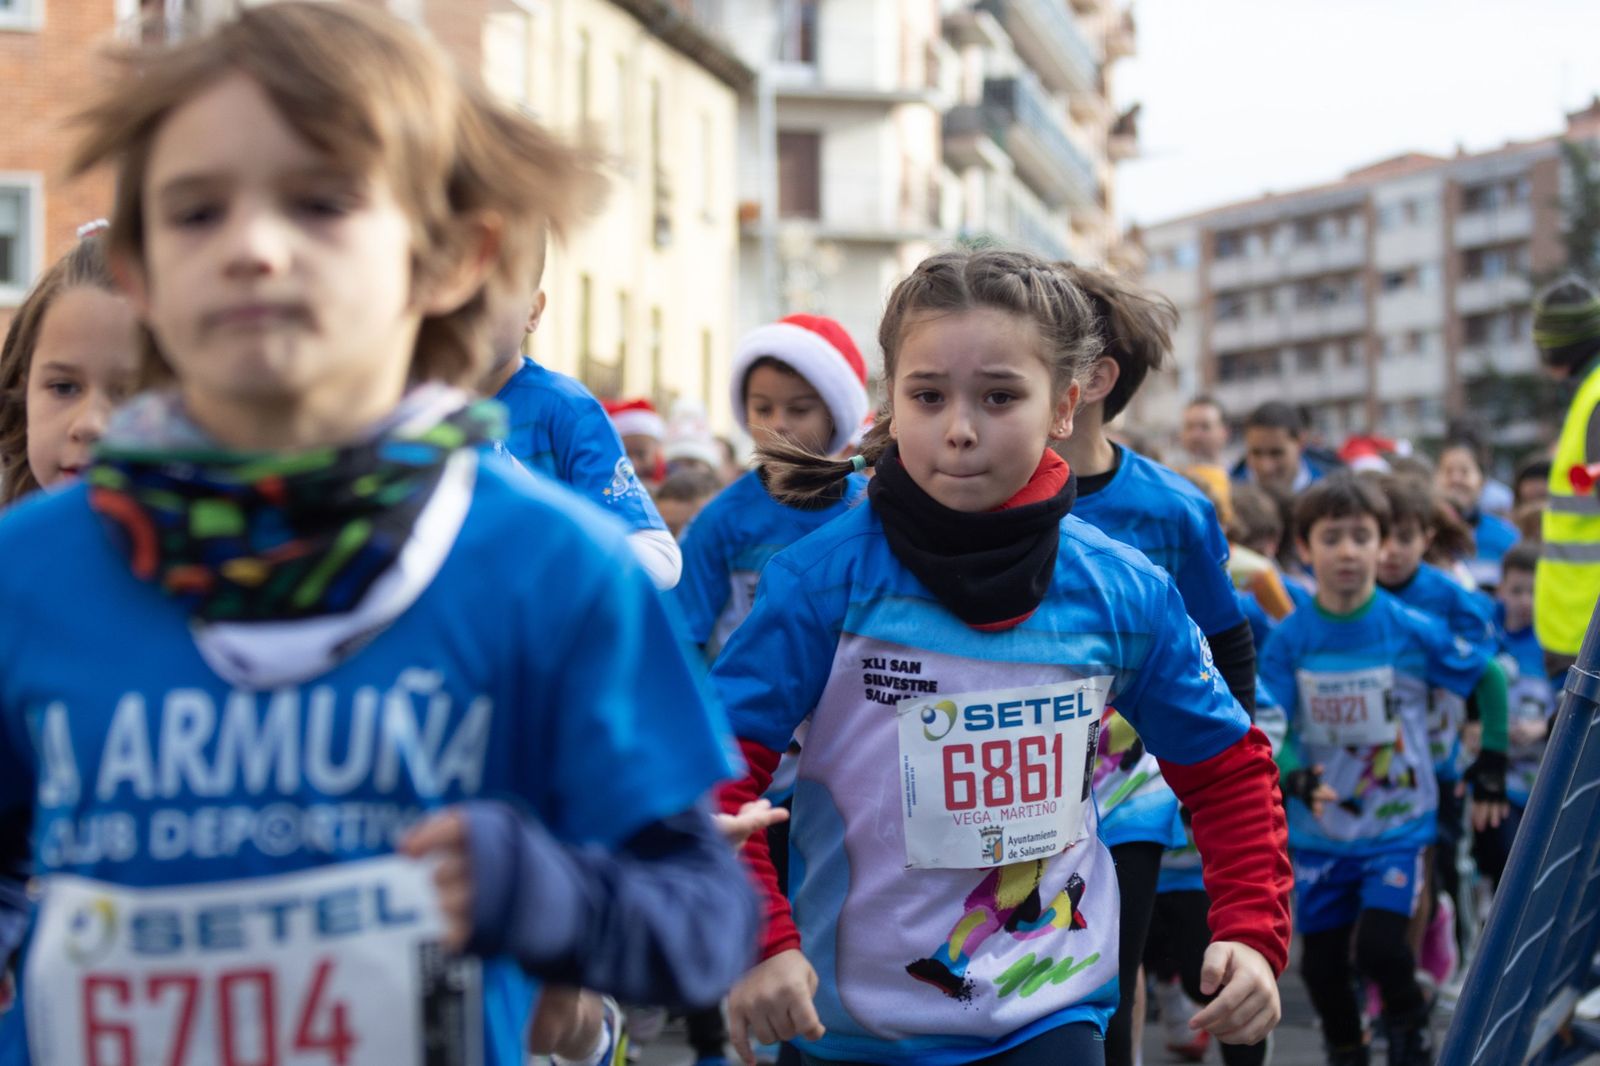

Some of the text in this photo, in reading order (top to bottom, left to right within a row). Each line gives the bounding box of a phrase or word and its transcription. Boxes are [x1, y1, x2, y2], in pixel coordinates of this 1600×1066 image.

[862, 657, 922, 675] XLI SAN
[863, 673, 938, 693] SILVESTRE
[963, 692, 1093, 732] SETEL
[94, 666, 493, 802] ARMUÑA
[942, 733, 1063, 812] 6861
[953, 801, 1057, 826] VEGA MARTIÑO
[1007, 829, 1058, 847] Ayuntamiento
[1007, 843, 1056, 860] de Salamanca
[130, 882, 418, 956] SETEL
[82, 954, 358, 1066] 6704
